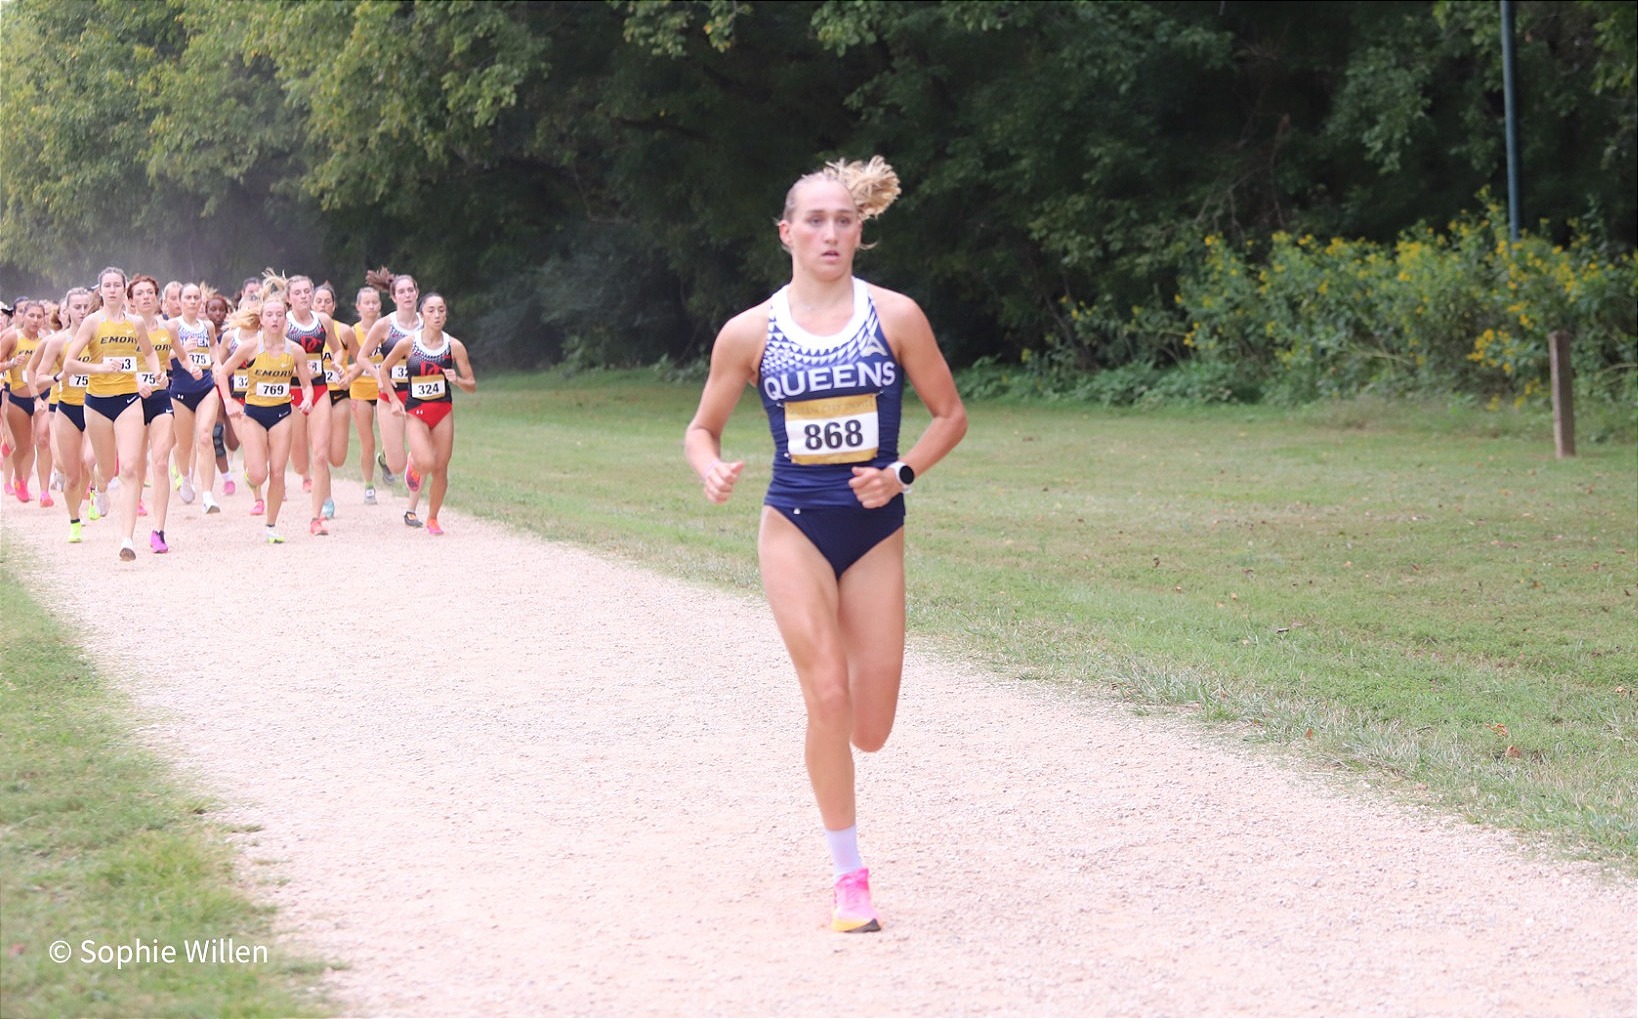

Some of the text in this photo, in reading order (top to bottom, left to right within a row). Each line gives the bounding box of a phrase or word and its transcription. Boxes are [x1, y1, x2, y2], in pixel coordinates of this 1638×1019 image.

[254, 369, 293, 377] EMORY
[397, 367, 408, 378] 32
[75, 375, 89, 386] 75
[141, 373, 156, 385] 75
[238, 377, 249, 387] 32
[763, 361, 896, 401] QUEENS
[263, 384, 285, 396] 769
[418, 383, 440, 395] 324
[803, 419, 864, 451] 868
